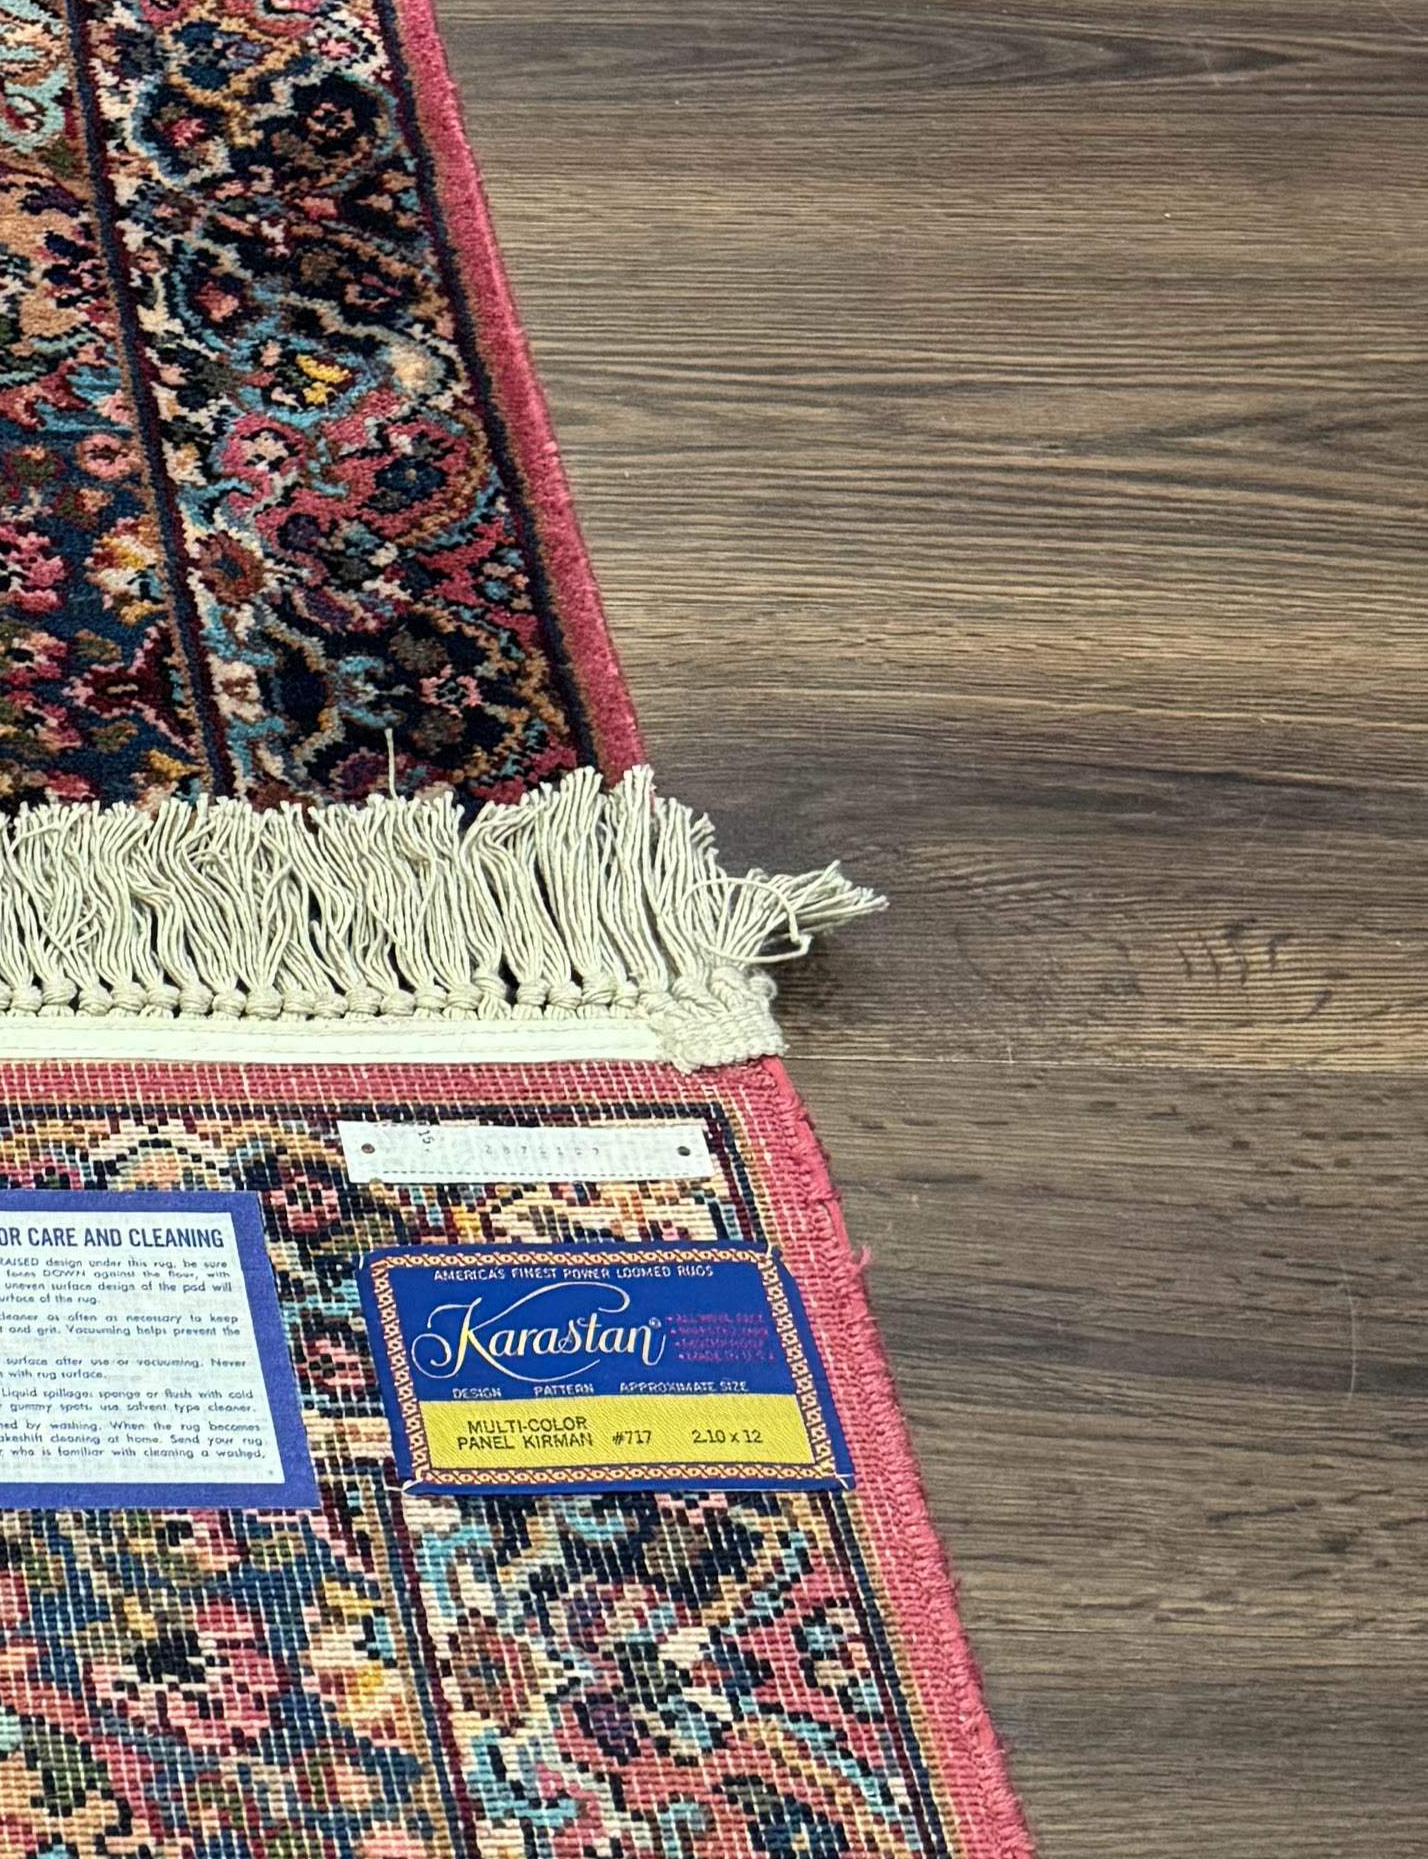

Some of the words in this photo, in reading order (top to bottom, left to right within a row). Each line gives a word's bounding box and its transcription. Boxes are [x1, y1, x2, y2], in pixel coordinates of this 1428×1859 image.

[26, 1226, 78, 1245] CARE
[81, 1226, 123, 1246] AND
[127, 1227, 224, 1247] CLEANING
[511, 1267, 557, 1279] FINEST
[563, 1267, 611, 1279] POWER
[617, 1266, 671, 1279] LOOMED
[677, 1265, 714, 1277] RUGS
[411, 1282, 666, 1381] Karastan
[452, 1387, 502, 1399] DESIGN
[533, 1383, 595, 1397] PATTERN
[619, 1381, 717, 1393] APPROXIMATE
[720, 1380, 749, 1392] SIZE
[467, 1416, 588, 1434] MULTI-COLOR
[457, 1434, 515, 1451] PANEL
[523, 1432, 594, 1449] KIRMAN
[612, 1430, 652, 1446] #717
[730, 1432, 740, 1443] x
[743, 1429, 764, 1444] 12
